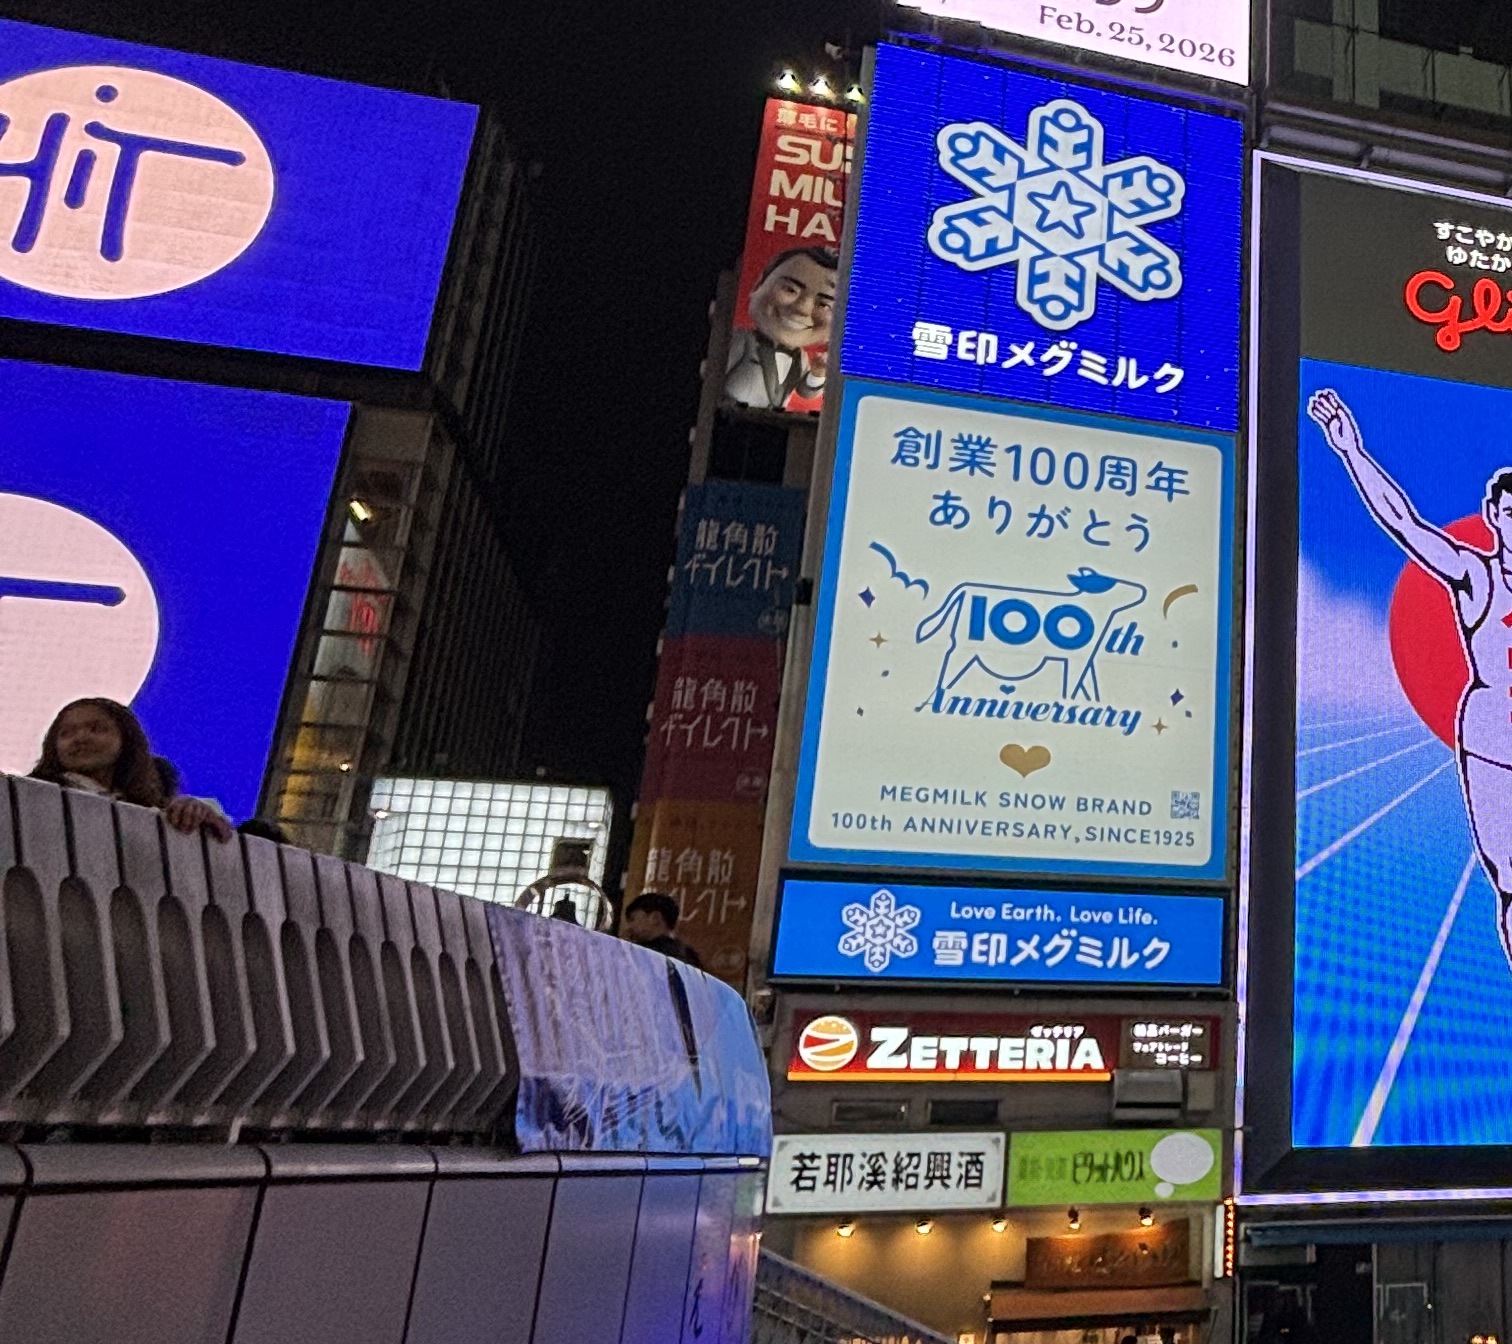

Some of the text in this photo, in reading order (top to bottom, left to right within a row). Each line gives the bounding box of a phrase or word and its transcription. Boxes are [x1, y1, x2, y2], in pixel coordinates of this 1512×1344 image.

[1039, 4, 1236, 68] Feb. 25, 2026
[911, 320, 1186, 395] 雪印メグミルク
[890, 424, 1191, 504] 創業100周年
[928, 489, 1153, 554] ありがとう
[914, 685, 1143, 737] Anniversary
[831, 811, 893, 833] 100th
[879, 783, 1154, 817] MEGMILK SNOW BRAND
[949, 900, 996, 920] Love
[1069, 905, 1113, 925] Love
[931, 929, 1173, 972] 雪印メグミルク
[866, 1025, 1105, 1072] ZETTERIA
